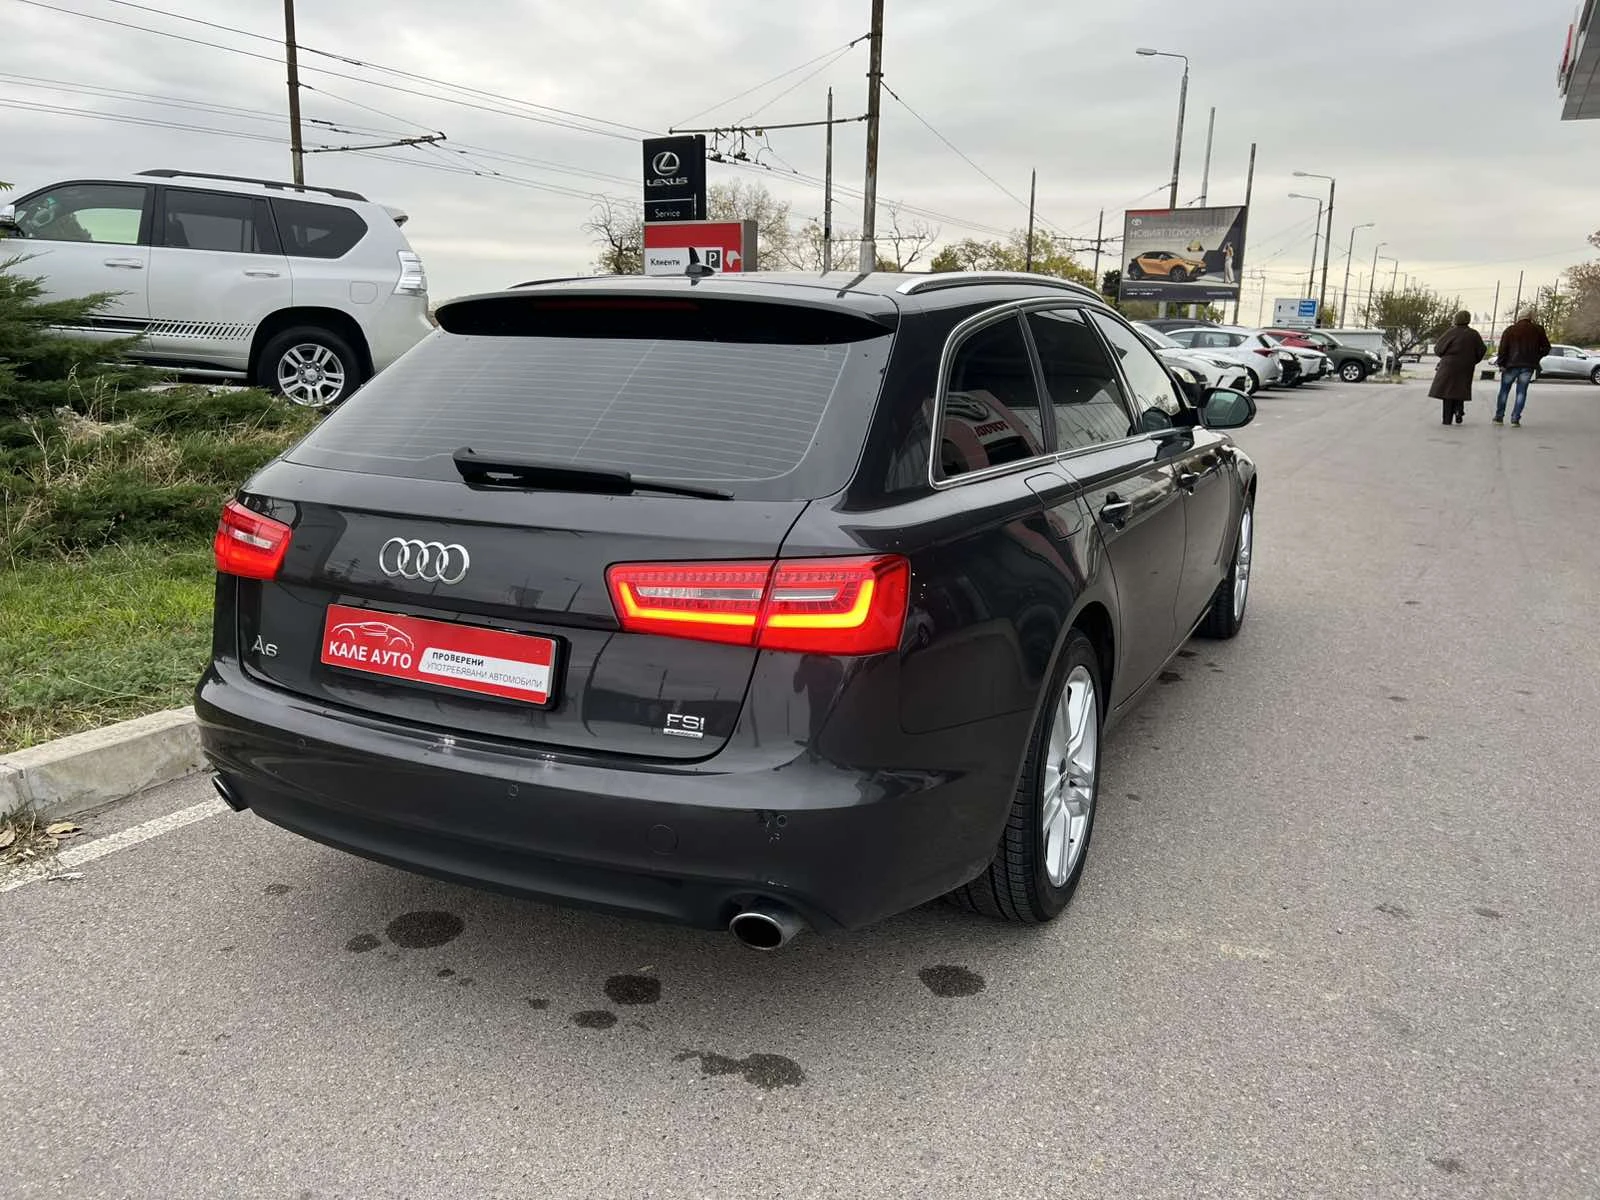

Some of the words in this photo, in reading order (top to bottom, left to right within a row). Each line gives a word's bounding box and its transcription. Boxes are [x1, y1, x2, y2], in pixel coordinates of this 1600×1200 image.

[646, 177, 688, 187] LEXUS
[655, 208, 680, 218] Service
[650, 258, 680, 266] Клиенти
[253, 635, 278, 657] A6
[329, 640, 368, 661] КАЛЕ
[370, 648, 412, 670] АУТО
[432, 651, 485, 667] ПРОВЕРЕНИ
[426, 662, 487, 678] УПОТРЕБЯВАНИ
[488, 672, 543, 688] АВТОМОБИЛИ
[667, 713, 704, 730] FSI
